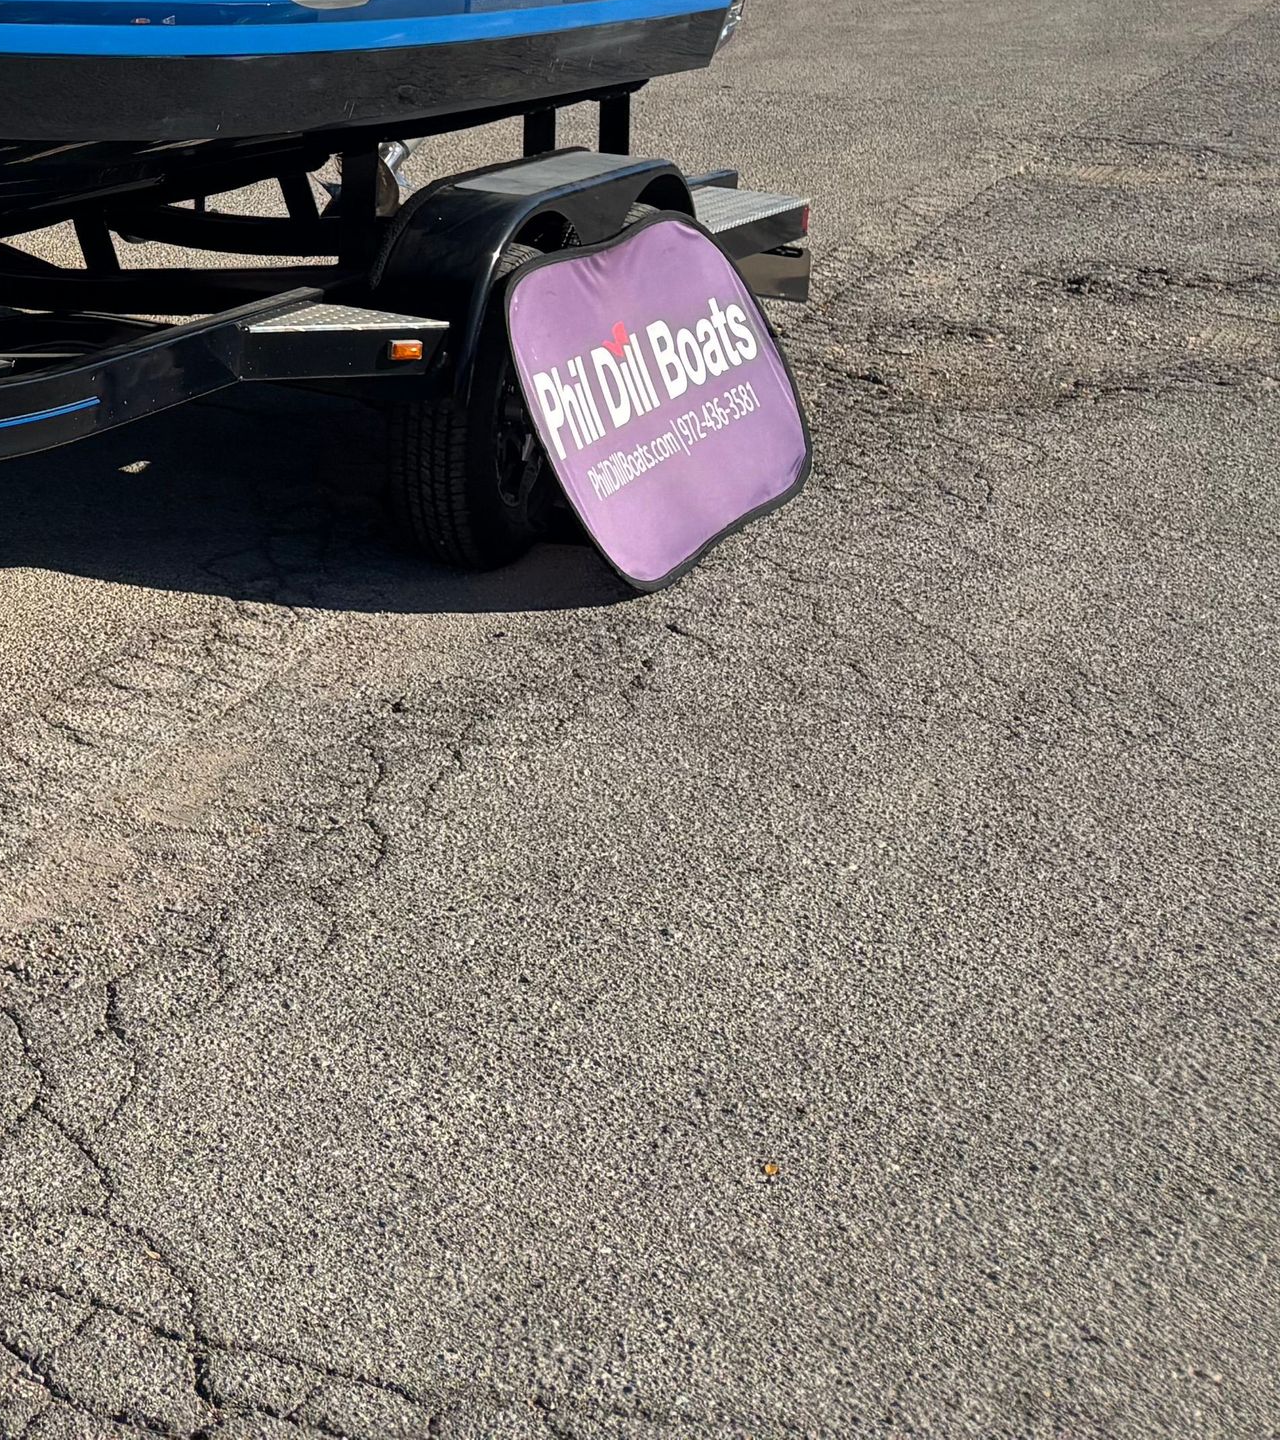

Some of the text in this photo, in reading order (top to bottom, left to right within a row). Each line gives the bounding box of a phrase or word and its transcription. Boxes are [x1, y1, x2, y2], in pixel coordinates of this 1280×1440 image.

[532, 297, 758, 461] Phil Dill Boats
